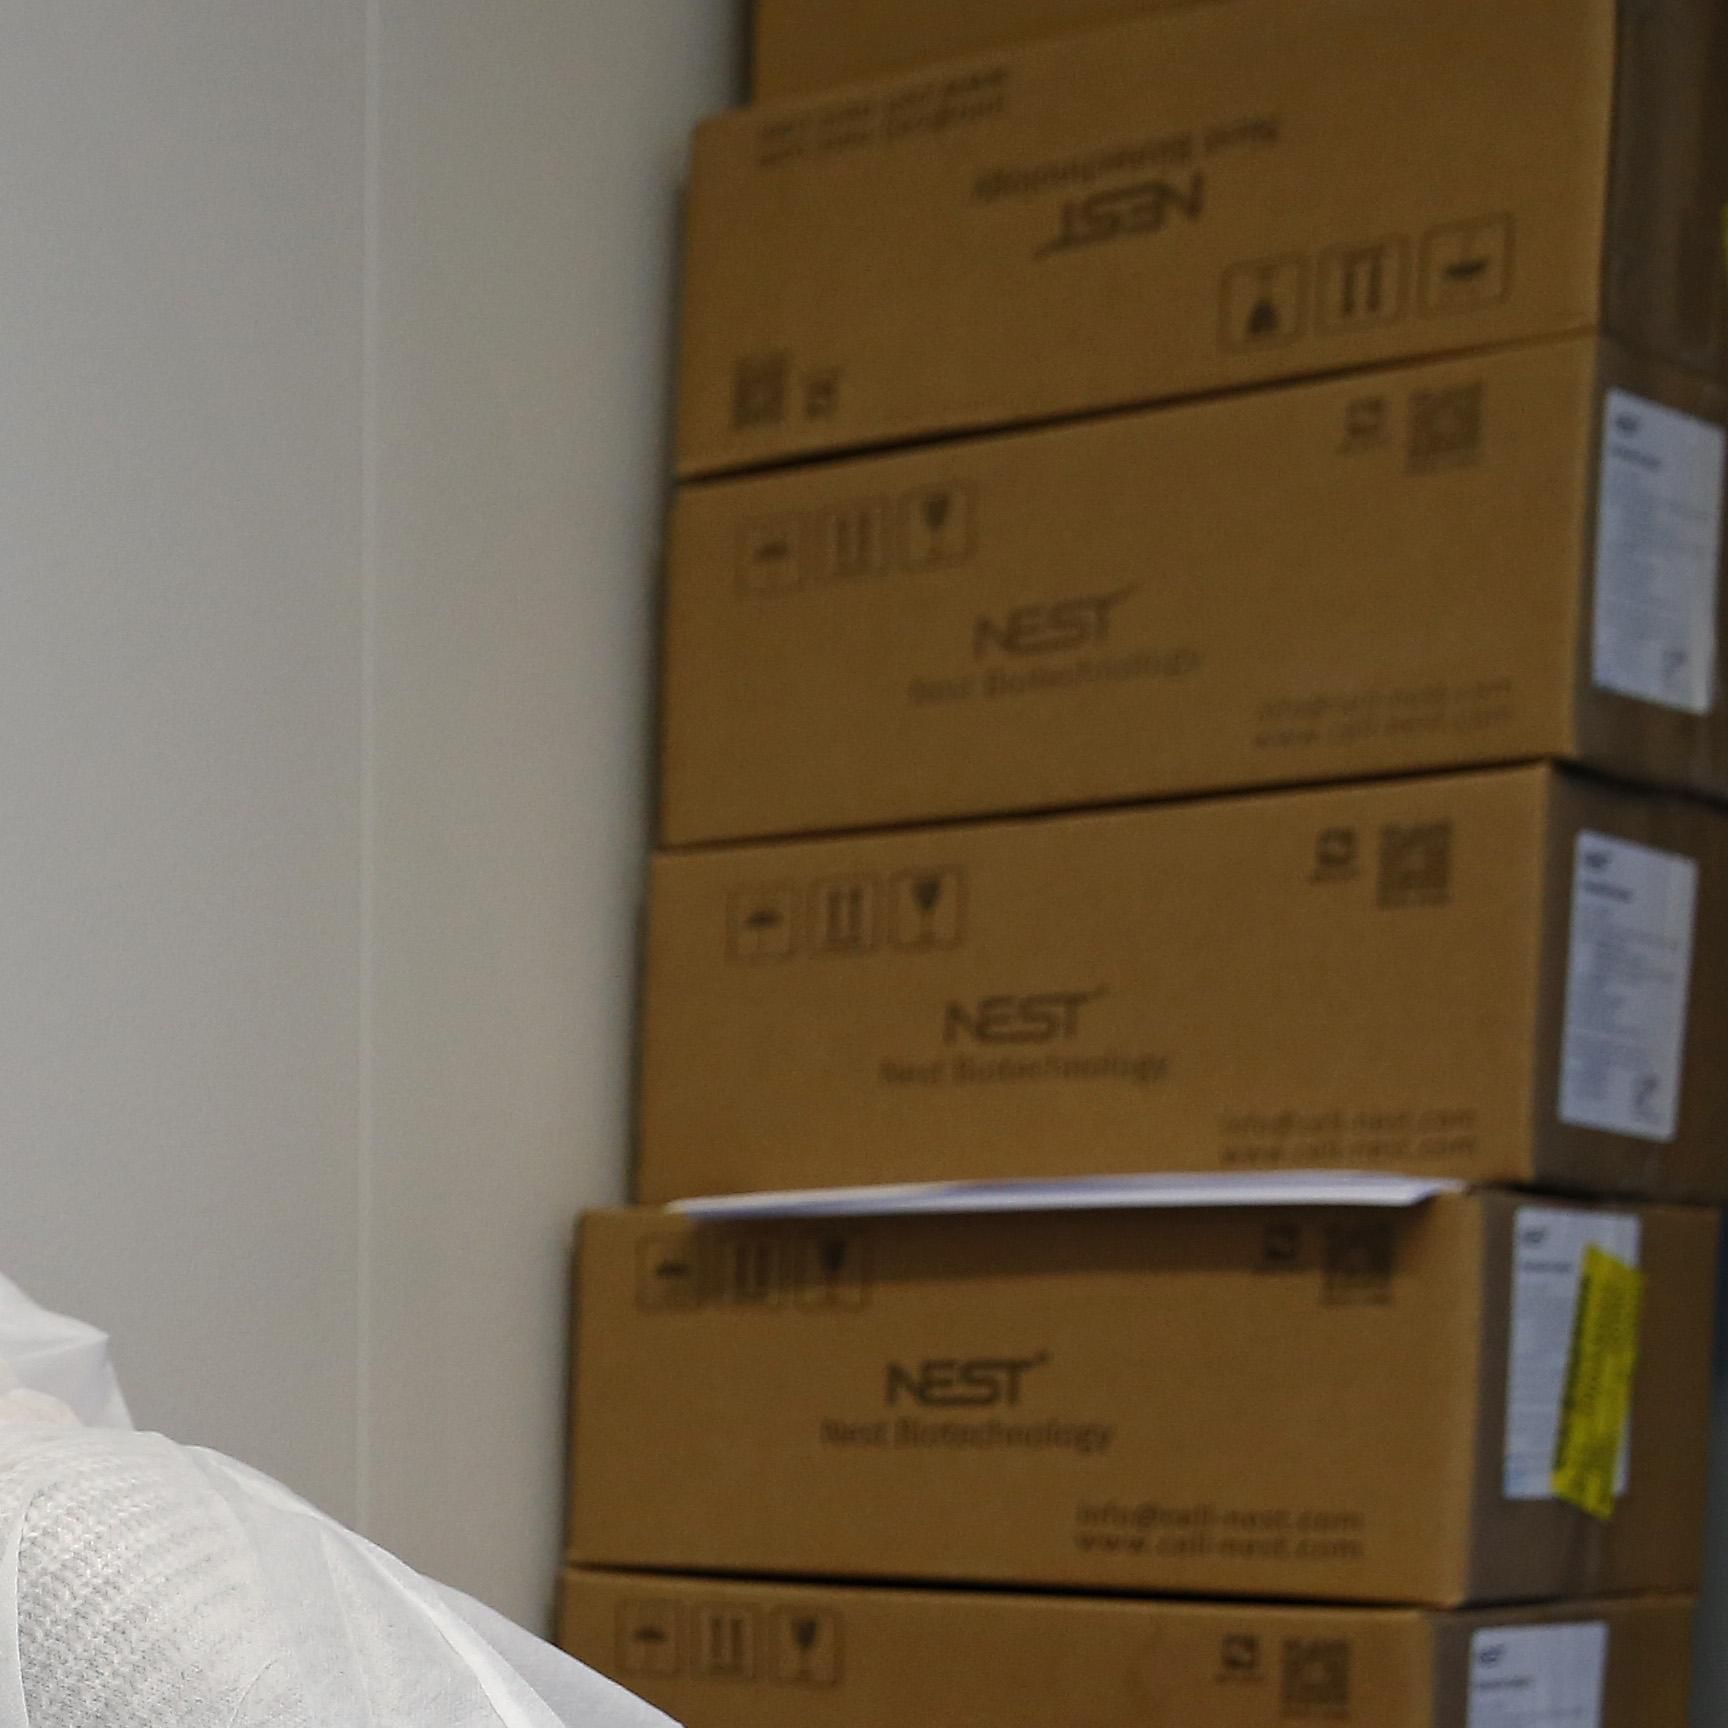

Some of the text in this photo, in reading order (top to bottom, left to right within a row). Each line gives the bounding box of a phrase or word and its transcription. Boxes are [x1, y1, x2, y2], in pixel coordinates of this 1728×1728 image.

[972, 586, 1138, 661] NEST
[944, 986, 1106, 1043] NEST
[883, 1352, 1051, 1410] NEST
[820, 1418, 1113, 1455] Nest Biotechnology
